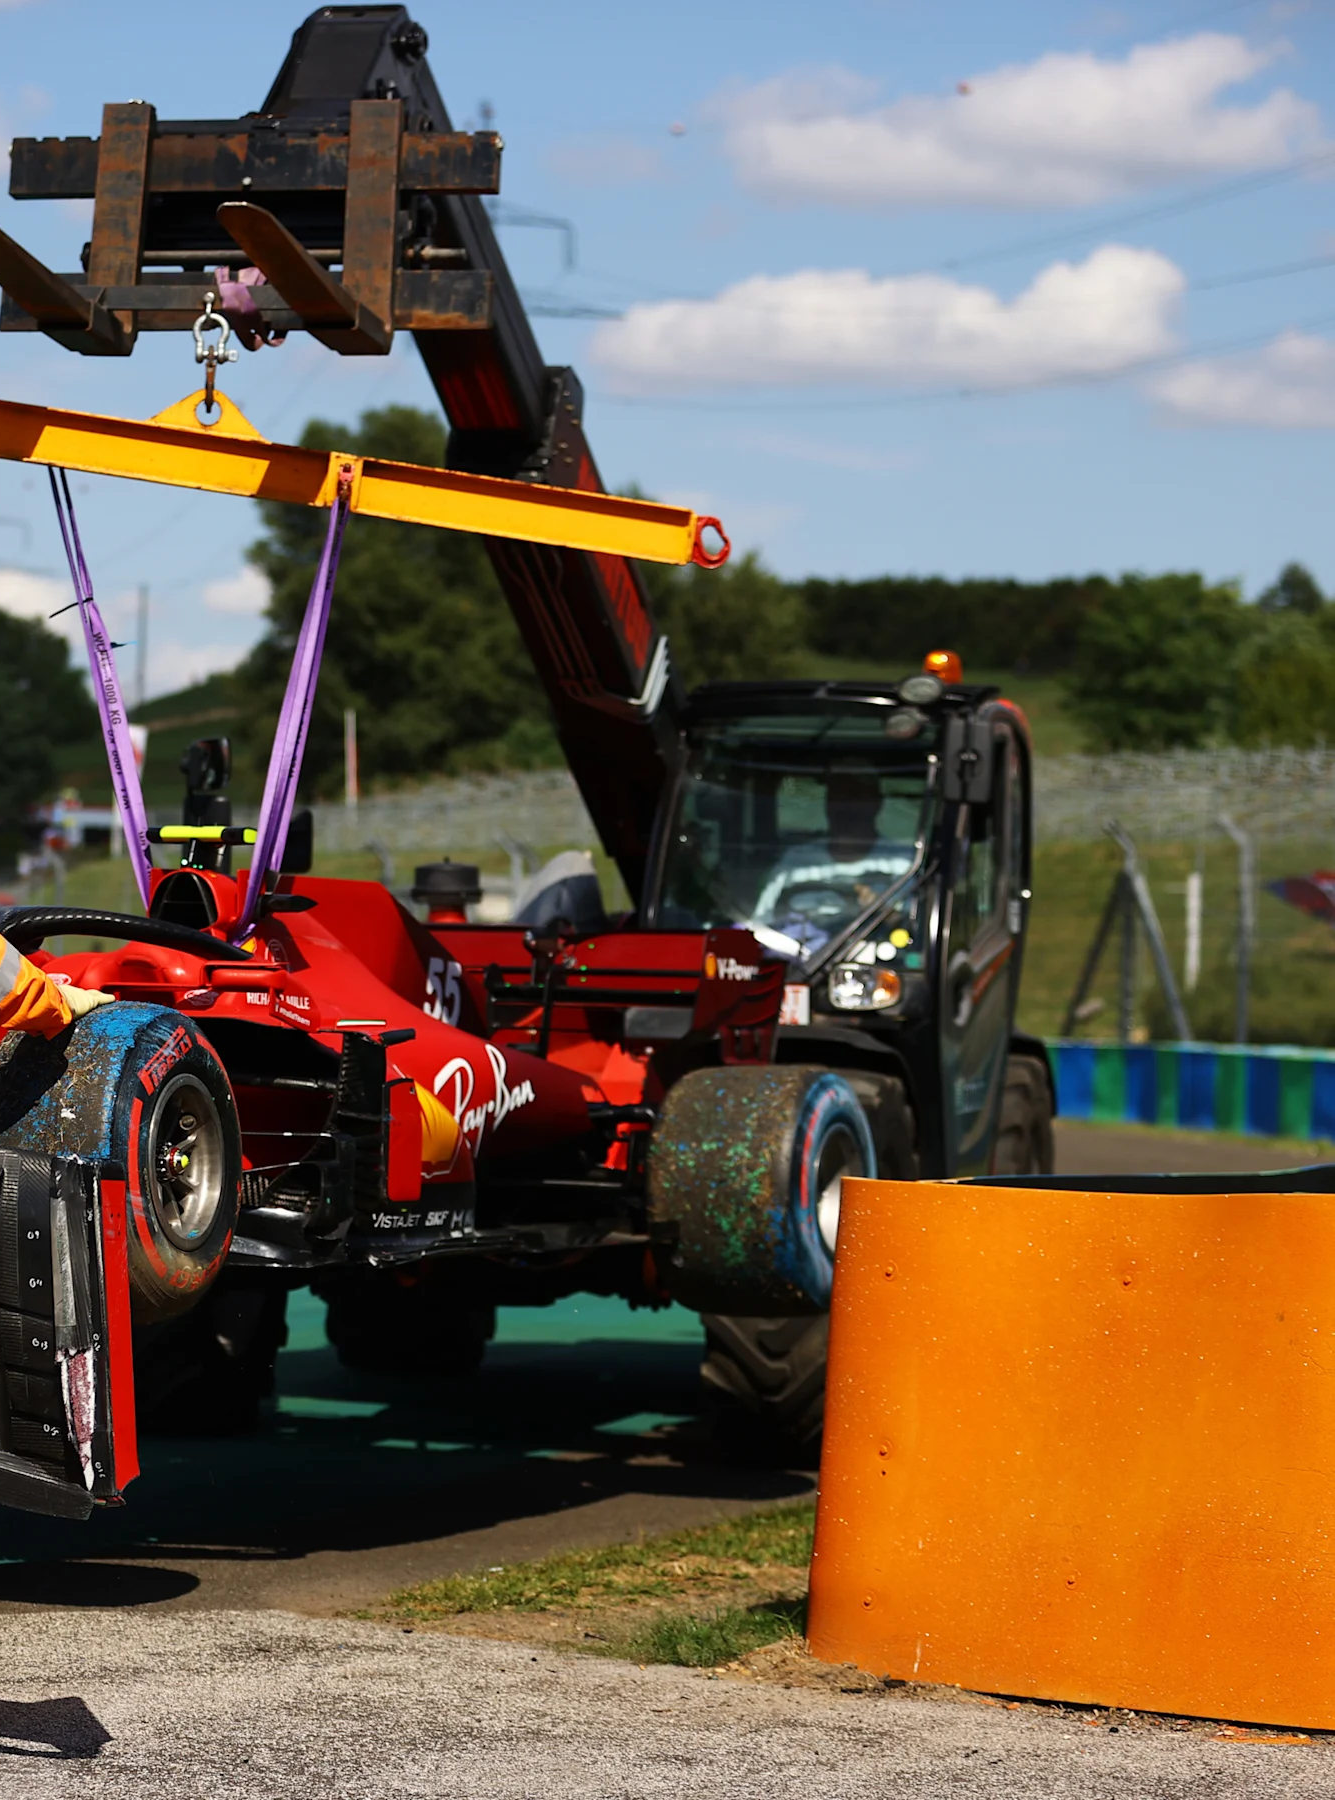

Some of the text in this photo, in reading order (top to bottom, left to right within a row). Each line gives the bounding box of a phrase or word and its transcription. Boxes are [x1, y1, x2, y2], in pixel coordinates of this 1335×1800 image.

[103, 677, 118, 705] 1000
[109, 708, 122, 726] KG
[286, 995, 311, 1011] MILLE
[423, 957, 462, 1029] 55
[372, 1212, 422, 1229] VISTAJET
[424, 1209, 450, 1227] SKF
